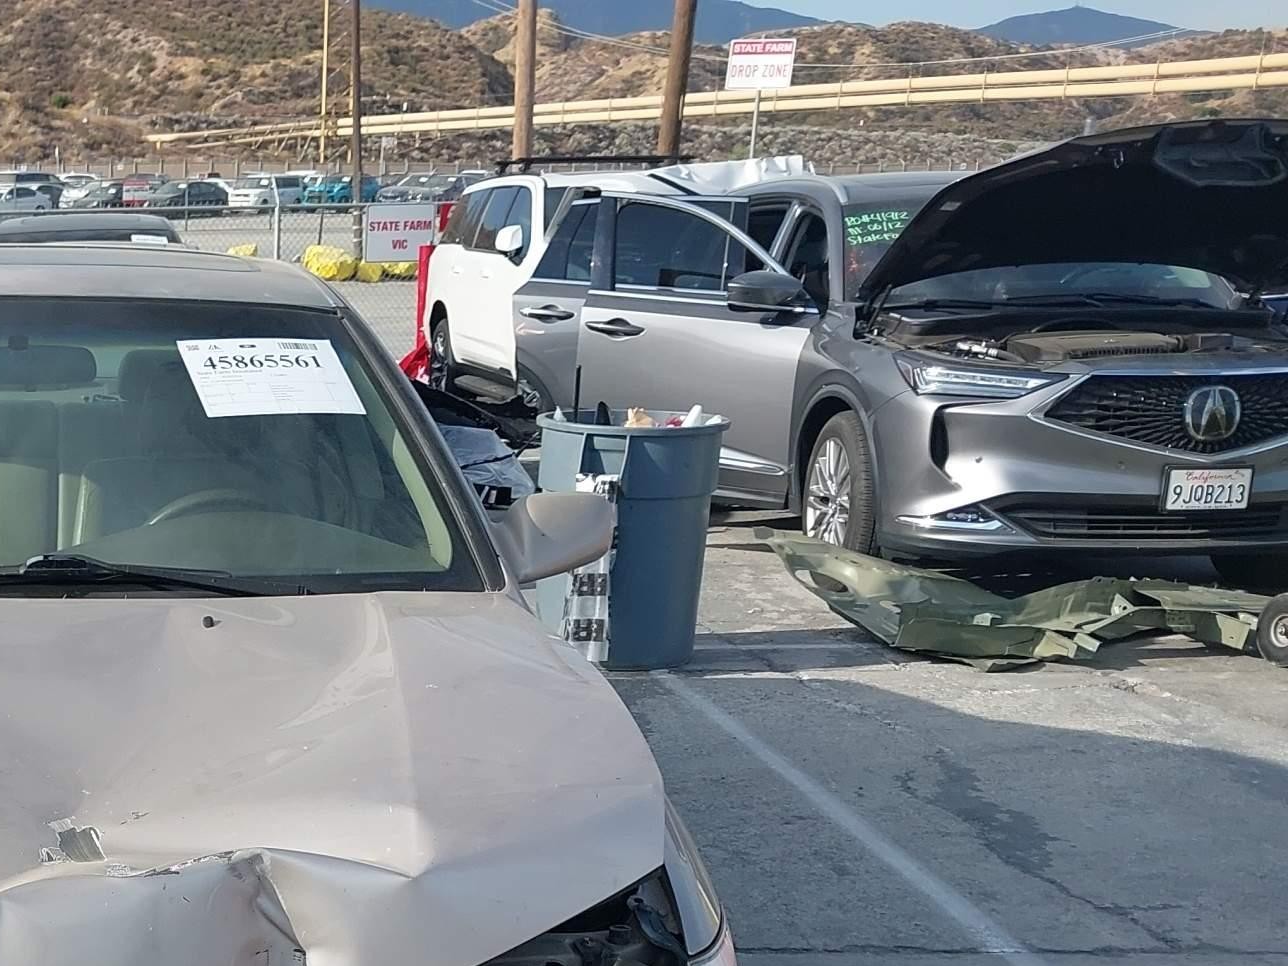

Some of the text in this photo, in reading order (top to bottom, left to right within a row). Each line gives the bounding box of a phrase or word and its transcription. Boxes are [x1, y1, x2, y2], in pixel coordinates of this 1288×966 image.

[734, 42, 792, 53] STATE FARM
[731, 64, 789, 78] DROP ZONE
[369, 220, 432, 232] STATE FARM
[391, 239, 408, 250] VIC
[203, 353, 323, 370] 45865561
[1171, 484, 1245, 504] 9JQB213
